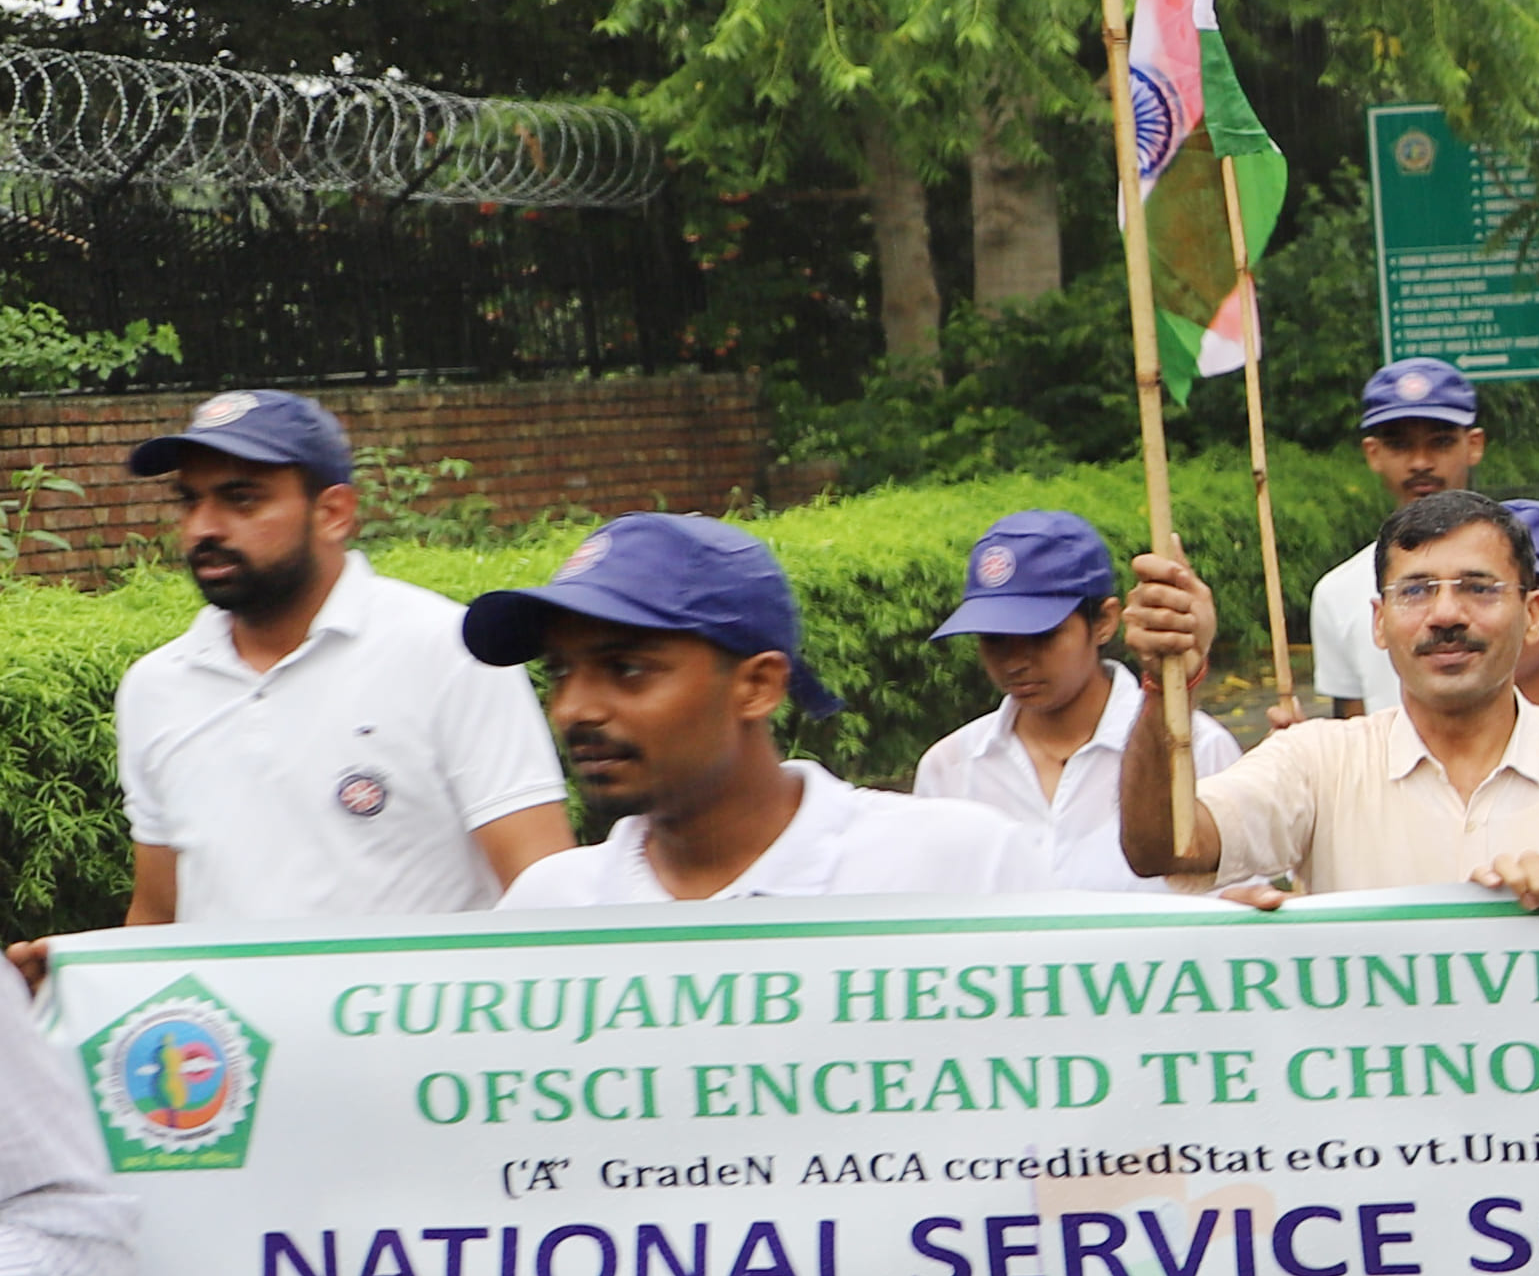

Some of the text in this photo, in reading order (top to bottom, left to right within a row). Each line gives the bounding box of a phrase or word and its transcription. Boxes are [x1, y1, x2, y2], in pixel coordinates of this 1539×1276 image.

[332, 970, 804, 1044] GURUJAMB
[416, 1064, 662, 1125] OFSCI
[691, 1053, 1113, 1118] ENCEAND
[1141, 1050, 1259, 1108] TE
[600, 1155, 777, 1189] GradeN
[800, 1152, 930, 1185] AACA
